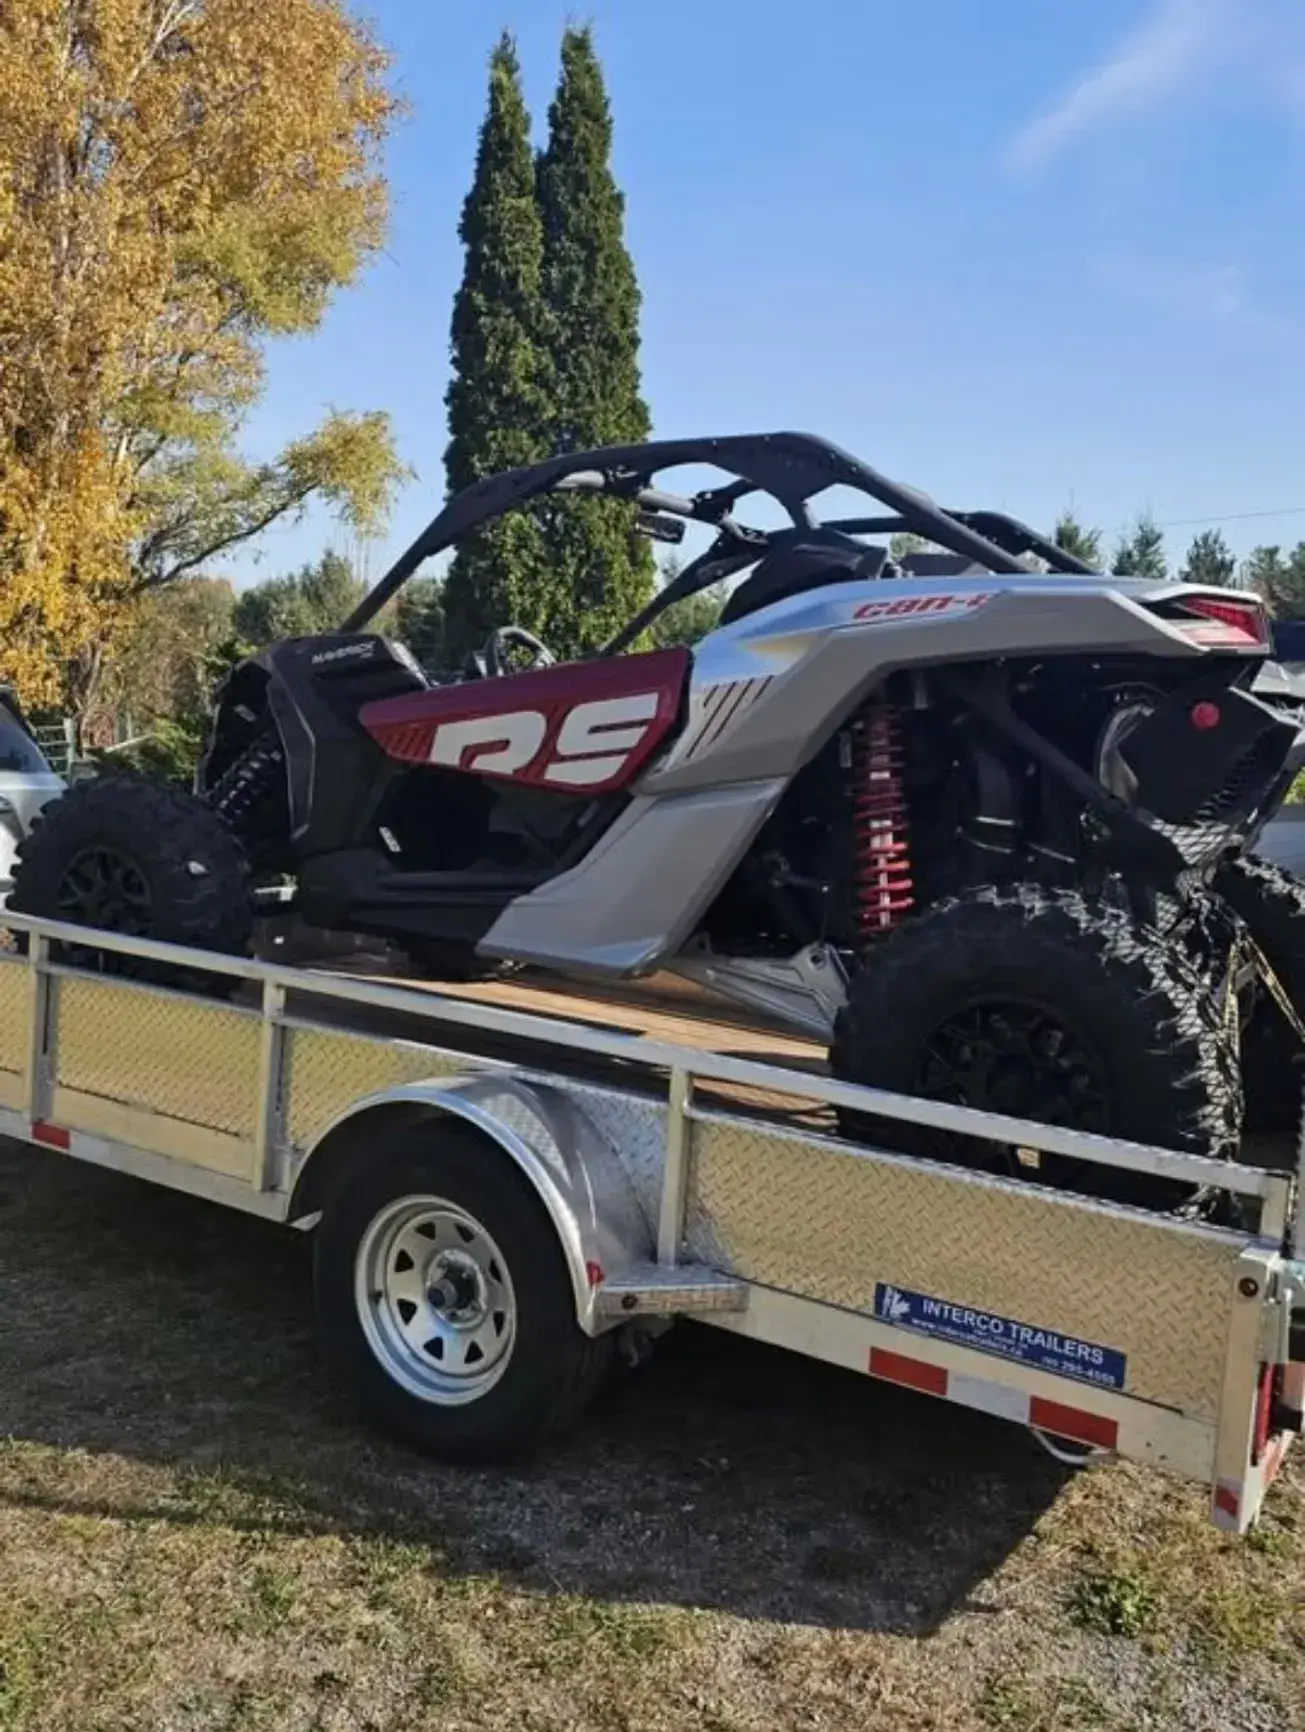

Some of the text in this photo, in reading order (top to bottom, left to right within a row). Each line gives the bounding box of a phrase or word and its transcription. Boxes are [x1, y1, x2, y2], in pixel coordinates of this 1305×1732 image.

[429, 692, 659, 785] RS
[922, 1299, 1004, 1334] INTERCO
[1010, 1323, 1104, 1364] TRAILERS
